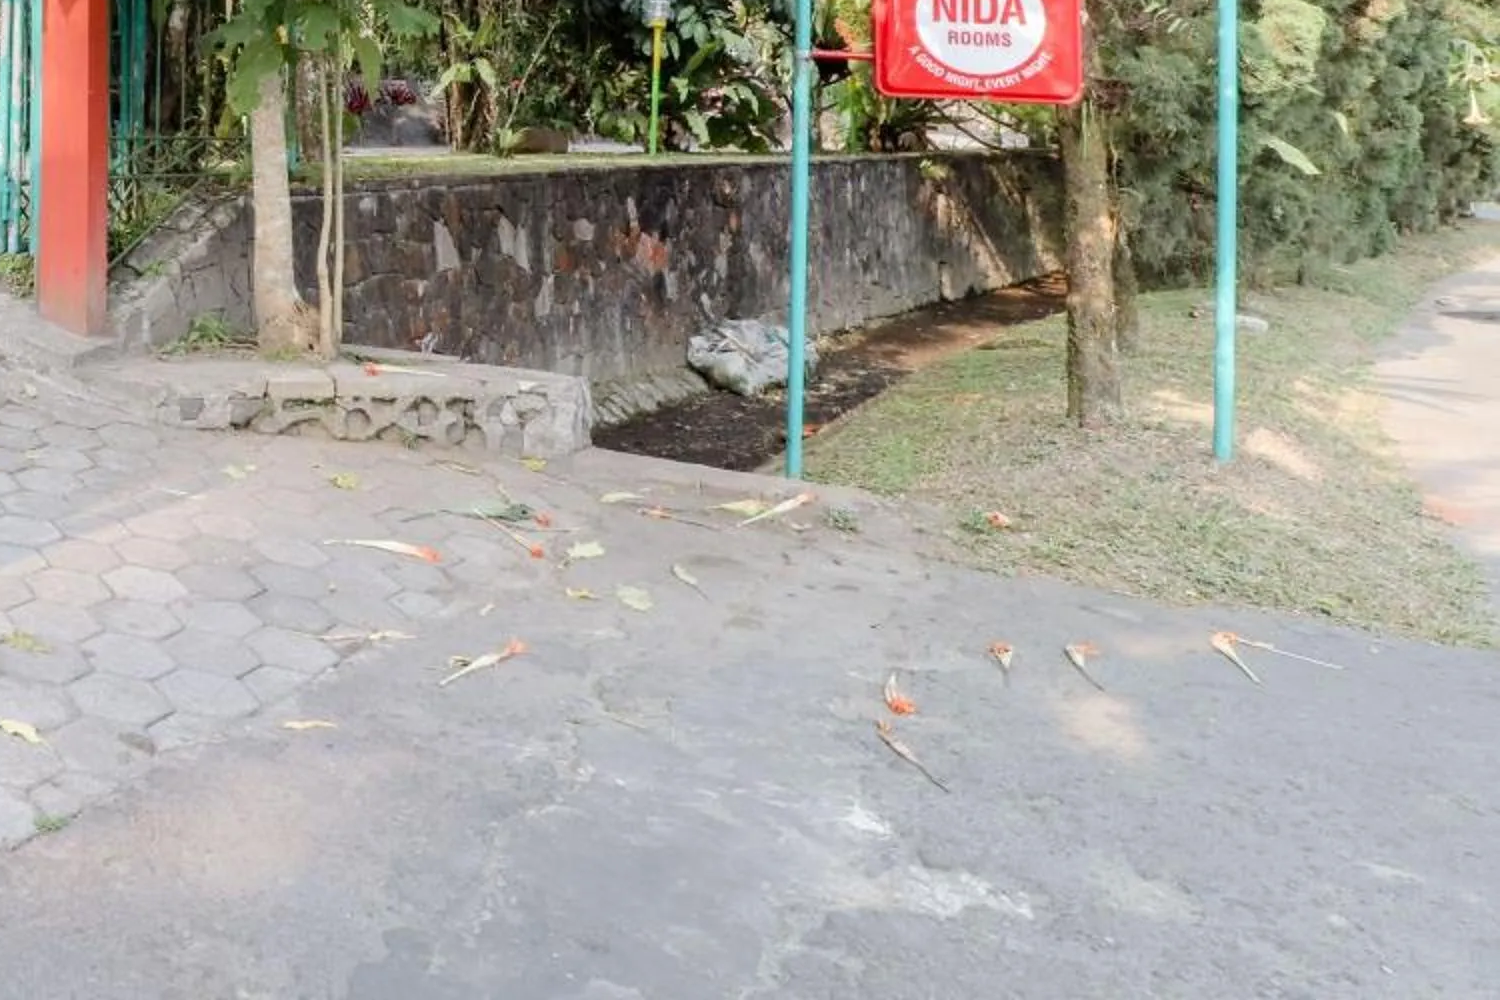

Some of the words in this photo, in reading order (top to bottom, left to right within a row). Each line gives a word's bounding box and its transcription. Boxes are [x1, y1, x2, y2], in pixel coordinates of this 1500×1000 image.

[947, 30, 1013, 48] ROOMS
[915, 53, 945, 78] GOOD
[983, 72, 1021, 89] EVERY
